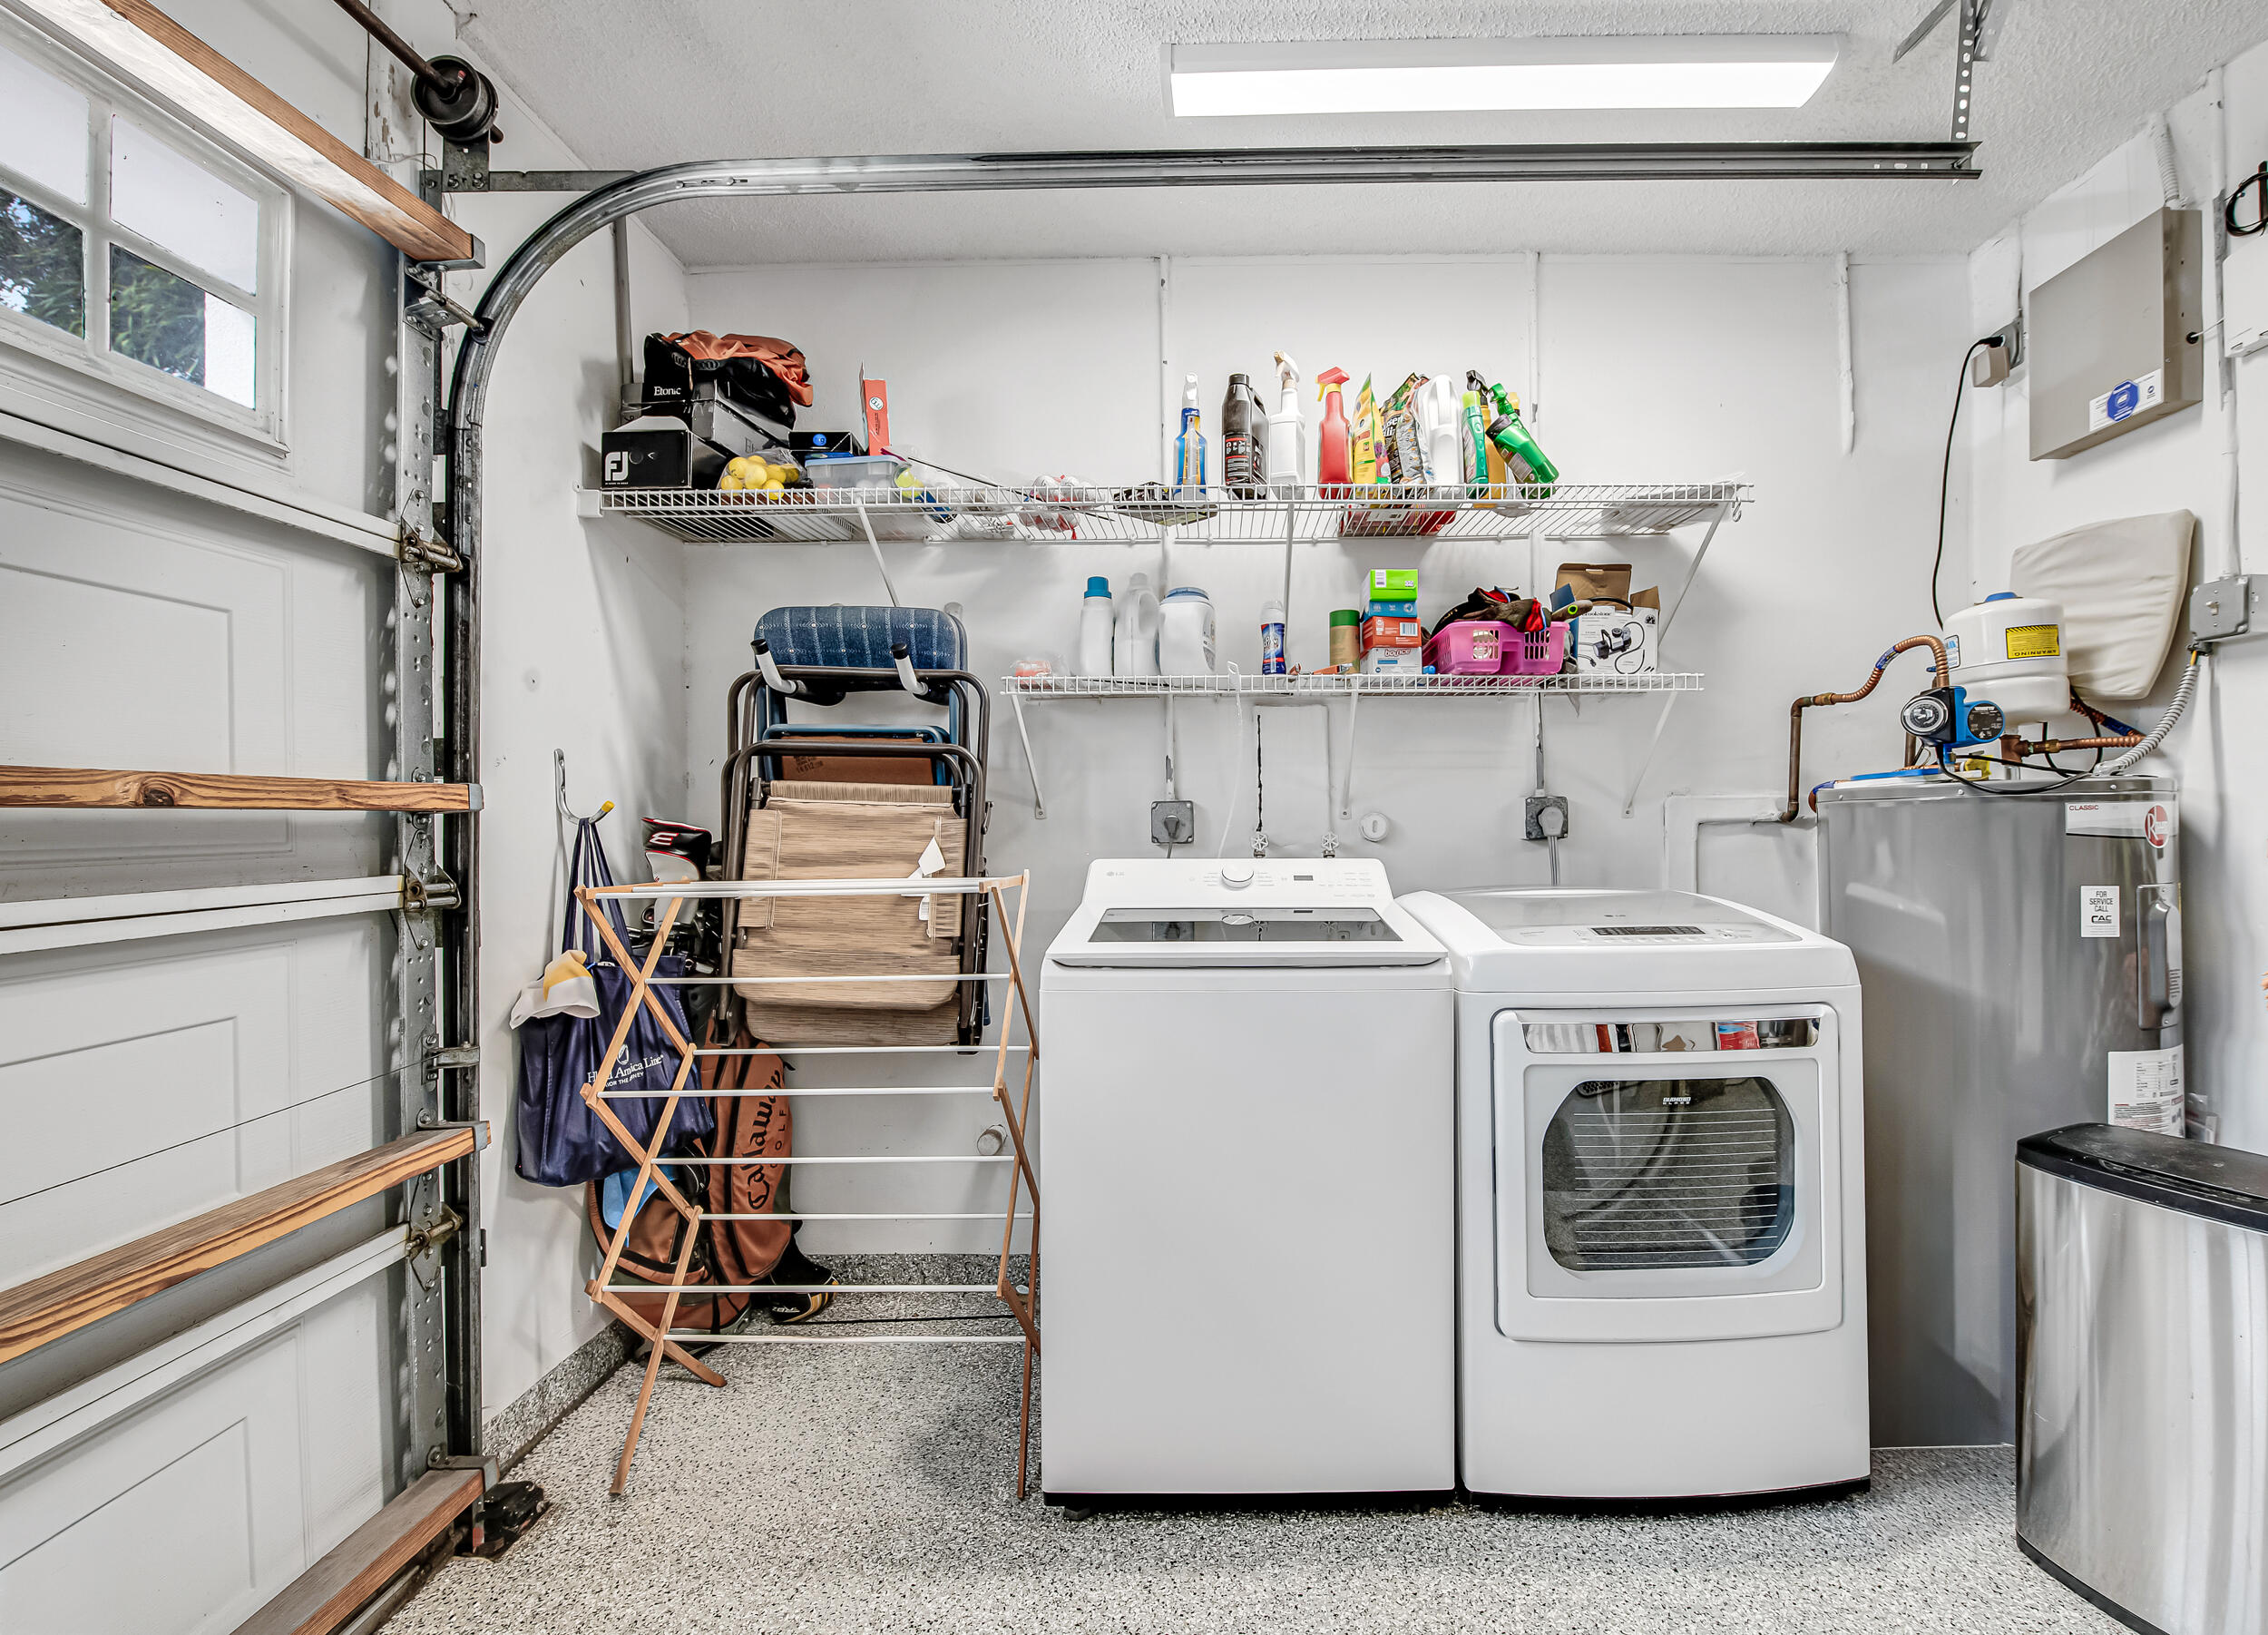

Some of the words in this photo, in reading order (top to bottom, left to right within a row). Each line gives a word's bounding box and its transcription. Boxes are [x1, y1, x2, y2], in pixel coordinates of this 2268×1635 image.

[653, 386, 682, 397] Etonic
[604, 451, 629, 482] FJ
[1384, 648, 1412, 657] bounce
[2096, 890, 2107, 898] FOR
[2089, 897, 2114, 906] SERVICE
[618, 1077, 629, 1085] THE
